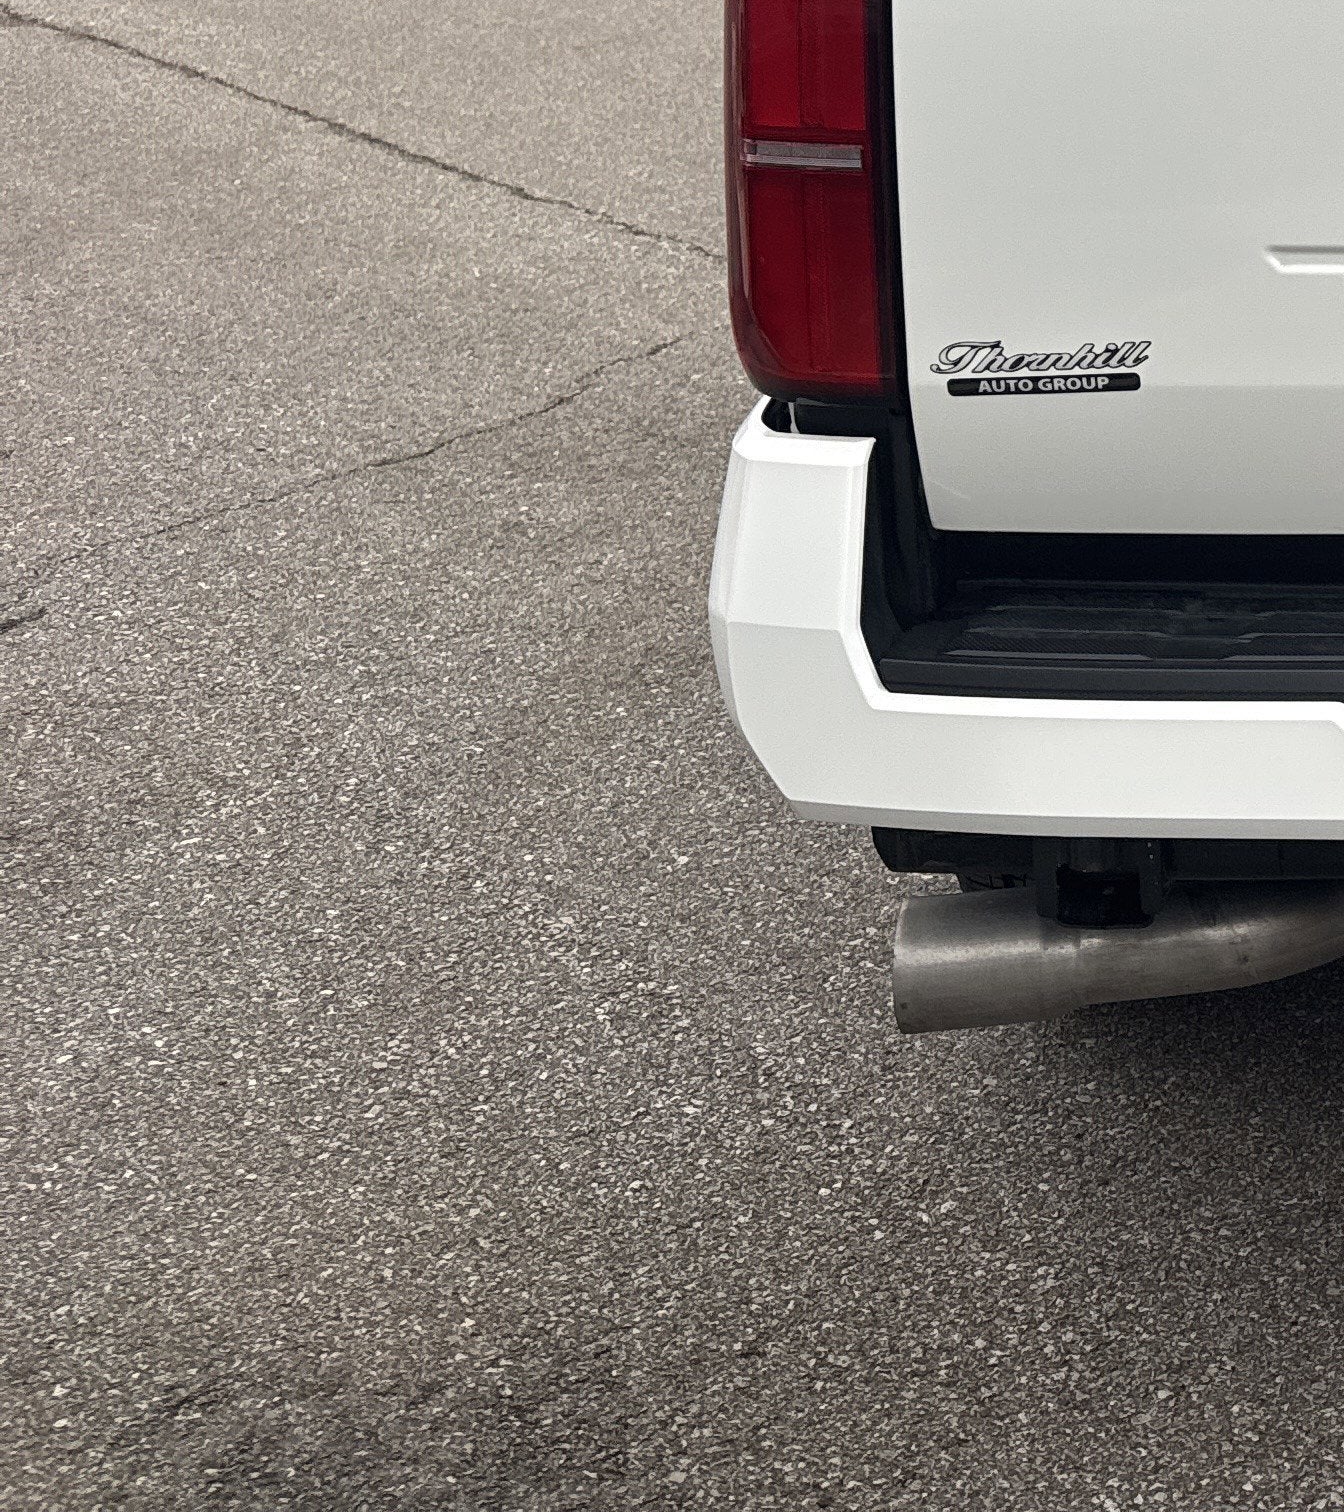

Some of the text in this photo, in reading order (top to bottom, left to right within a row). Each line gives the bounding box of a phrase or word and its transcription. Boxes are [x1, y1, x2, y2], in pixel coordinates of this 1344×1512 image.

[930, 340, 1151, 374] Thornhill
[978, 376, 1109, 393] AUTO GROUP
